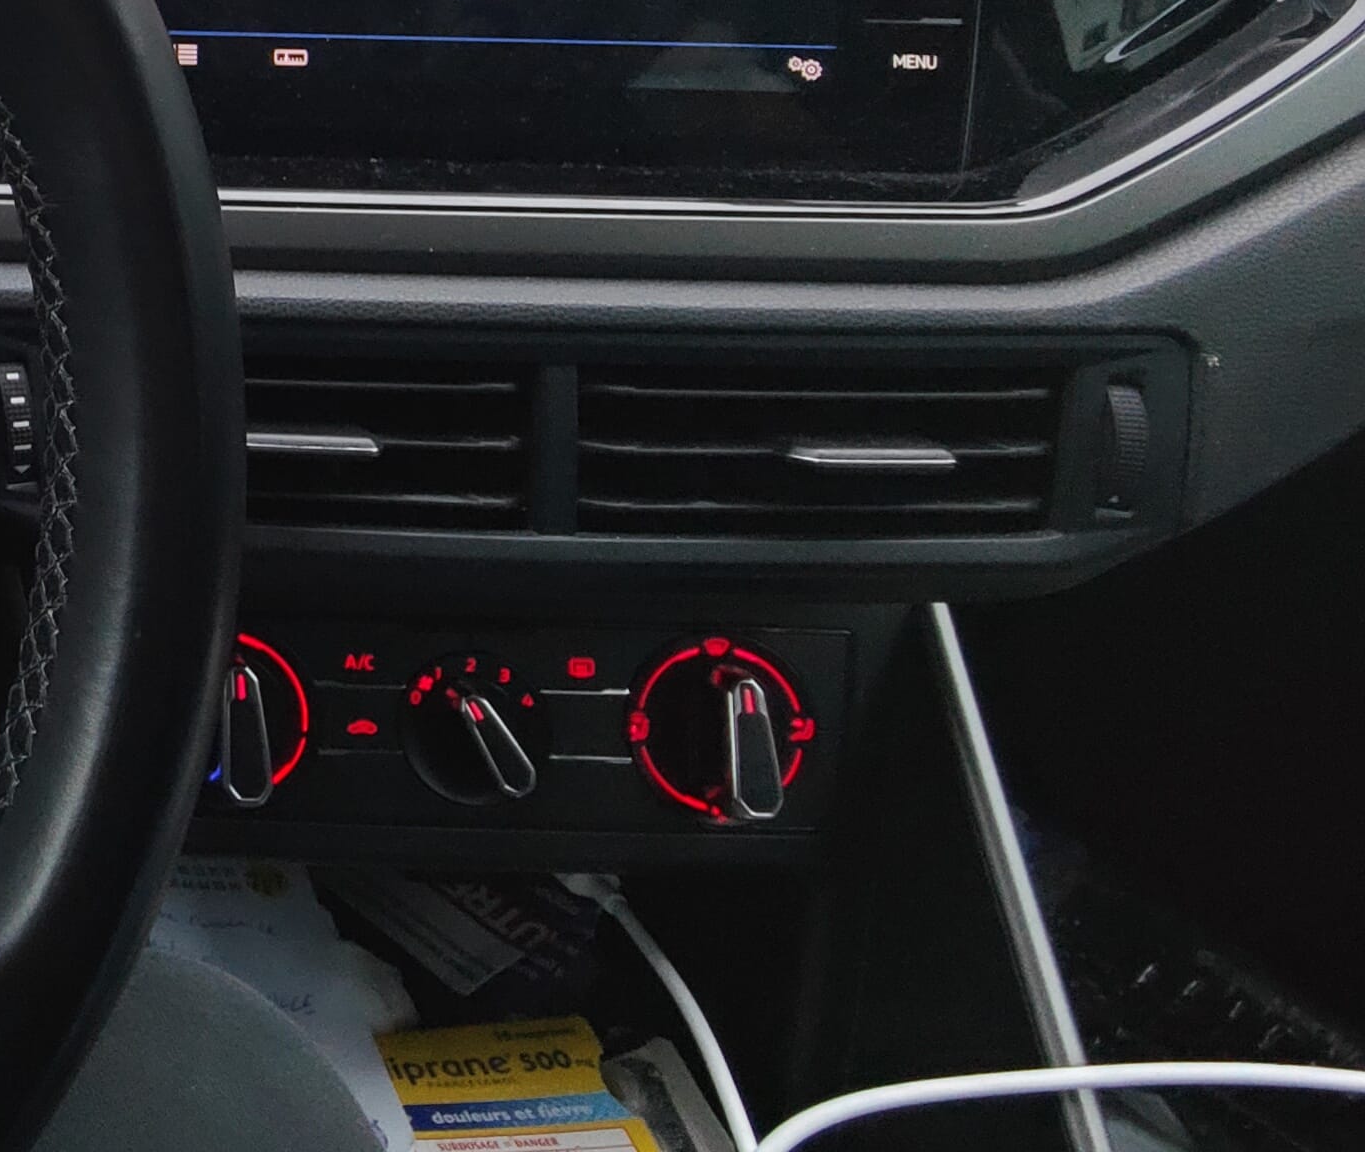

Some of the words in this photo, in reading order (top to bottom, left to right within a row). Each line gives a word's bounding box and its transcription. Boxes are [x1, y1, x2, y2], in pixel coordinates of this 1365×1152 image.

[892, 53, 938, 70] MENU
[344, 654, 375, 671] A/C
[465, 657, 477, 673] 2
[499, 667, 512, 684] 3
[521, 693, 535, 708] 4
[386, 1054, 511, 1085] iprane
[518, 1049, 572, 1073] 500
[430, 1109, 511, 1125] douleurs
[516, 1109, 536, 1121] et
[436, 1139, 500, 1152] SURDOSAGE
[514, 1136, 559, 1149] DANGER
